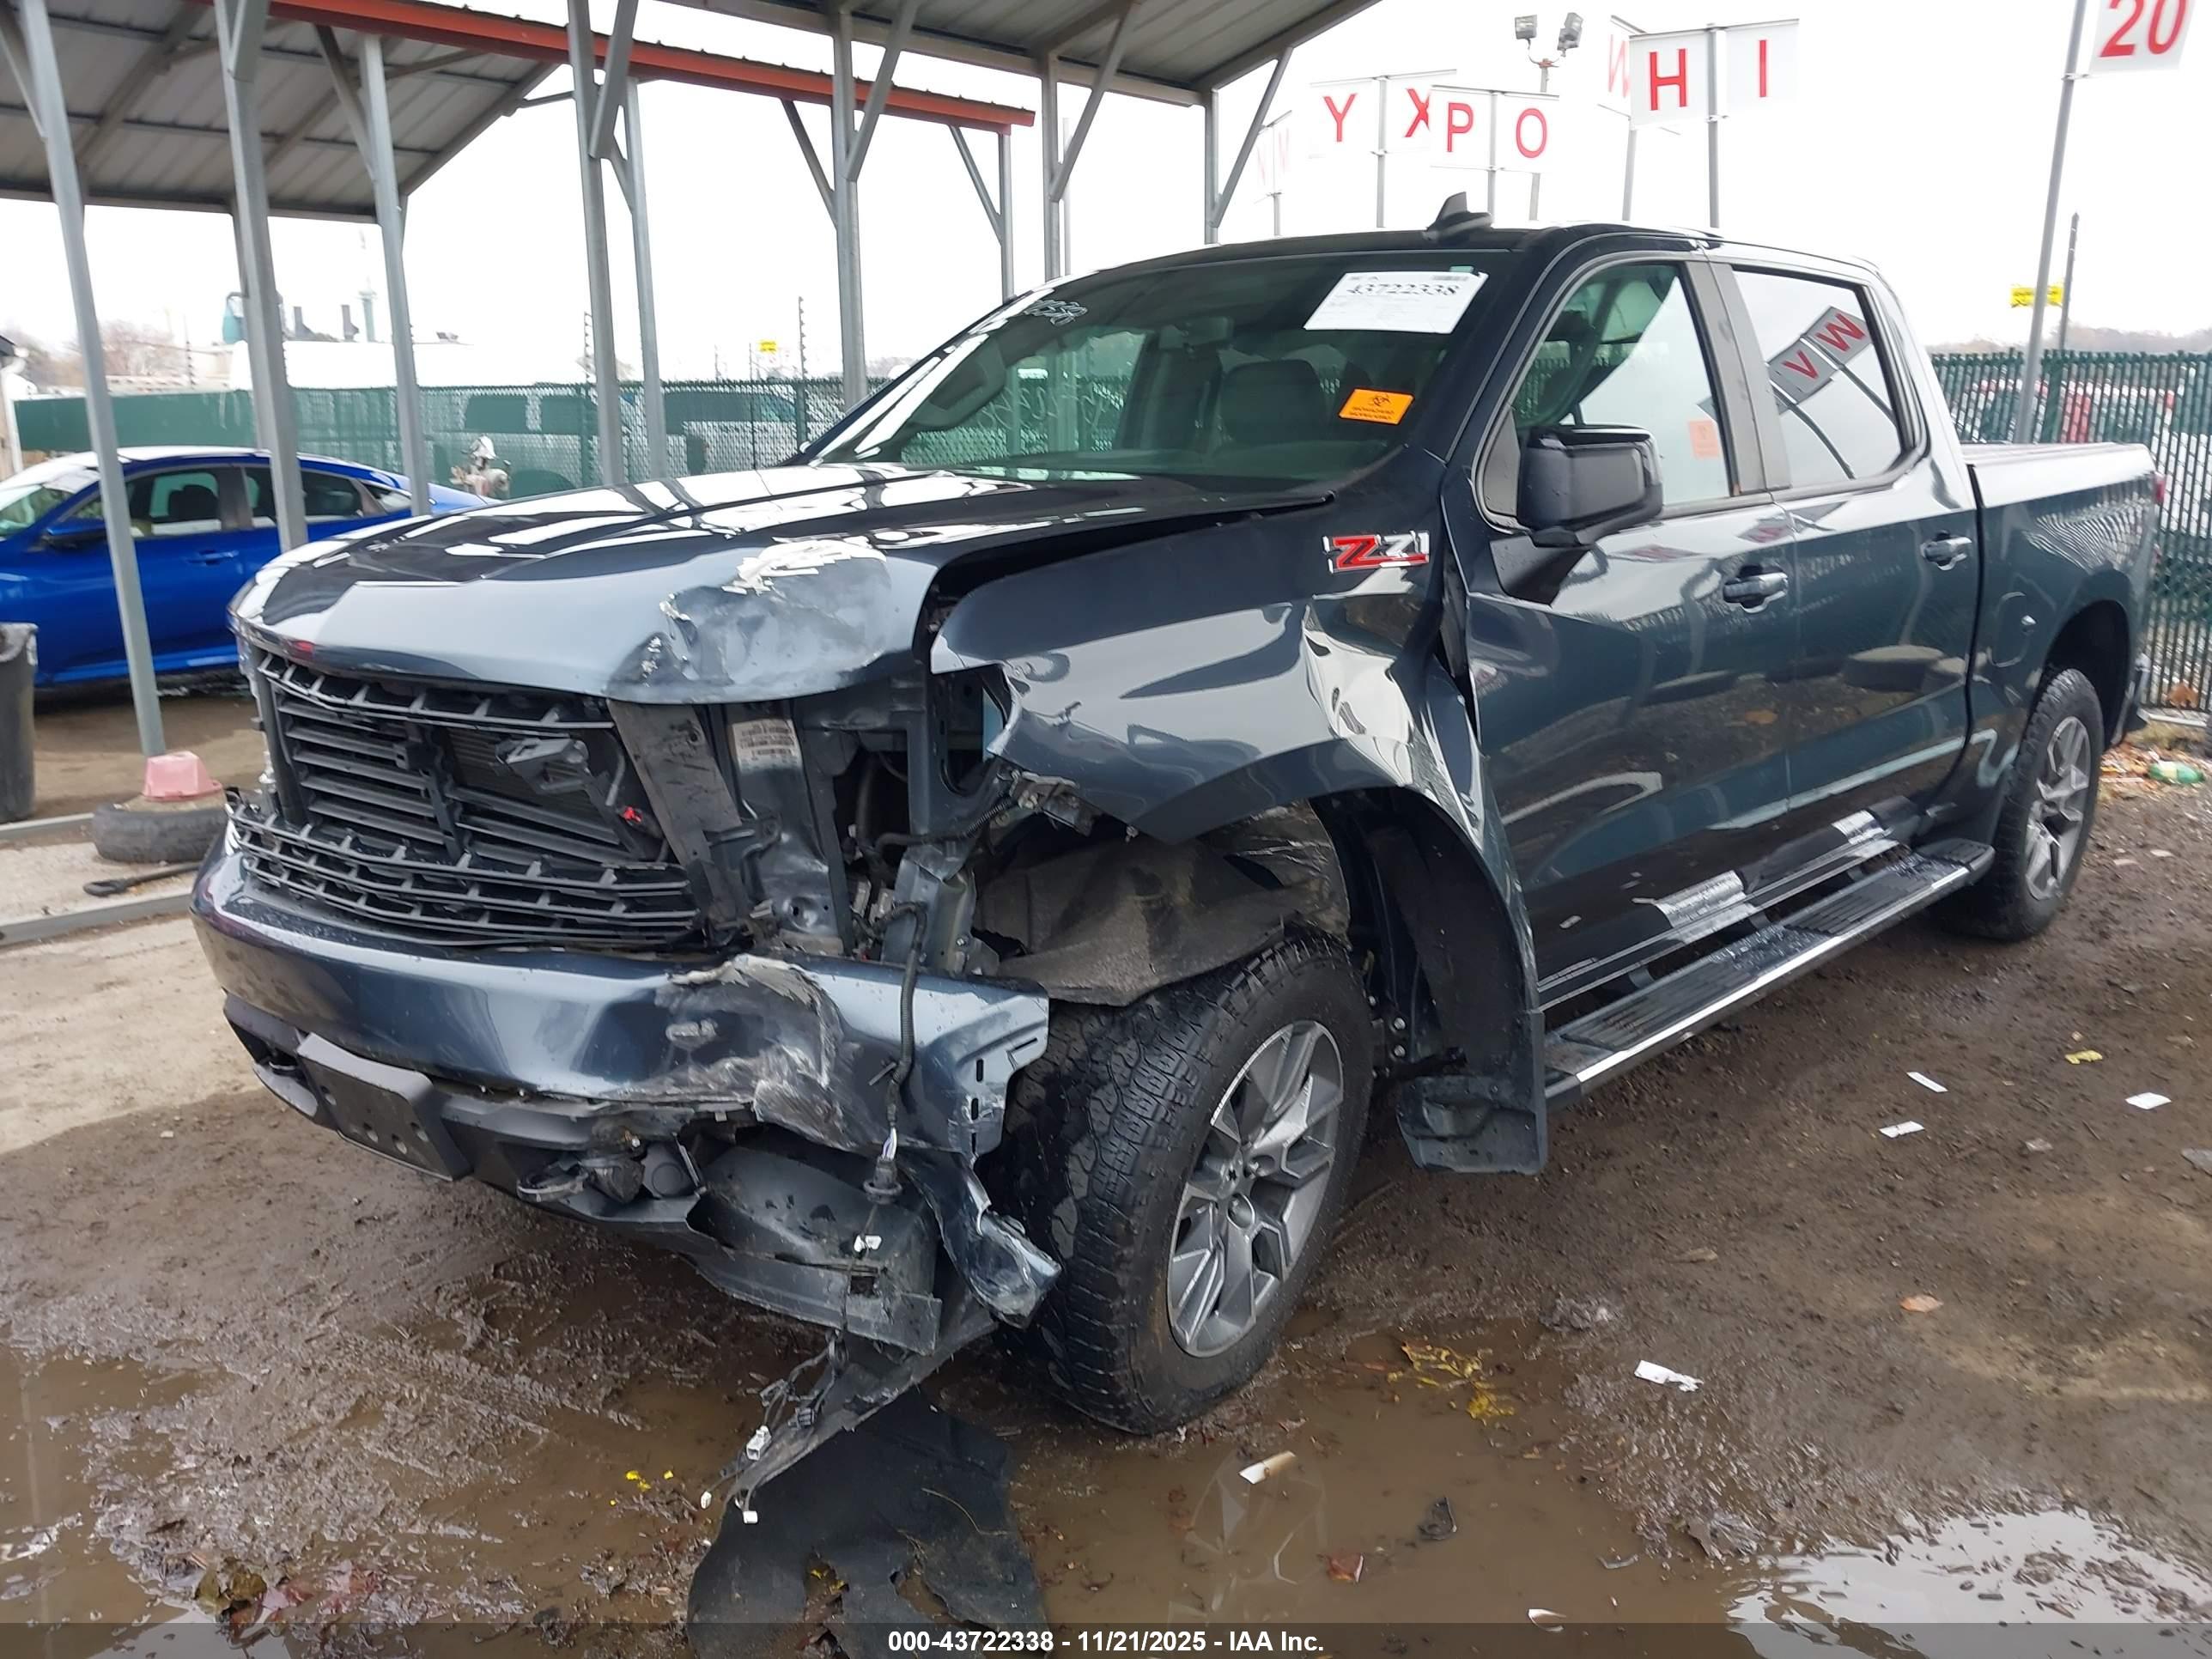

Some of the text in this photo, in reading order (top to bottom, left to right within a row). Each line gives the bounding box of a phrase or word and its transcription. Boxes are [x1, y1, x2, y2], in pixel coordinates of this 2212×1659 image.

[2099, 0, 2188, 58] 20
[1648, 39, 1768, 111] H I
[1323, 93, 1358, 143] Y
[1445, 101, 1548, 158] P O
